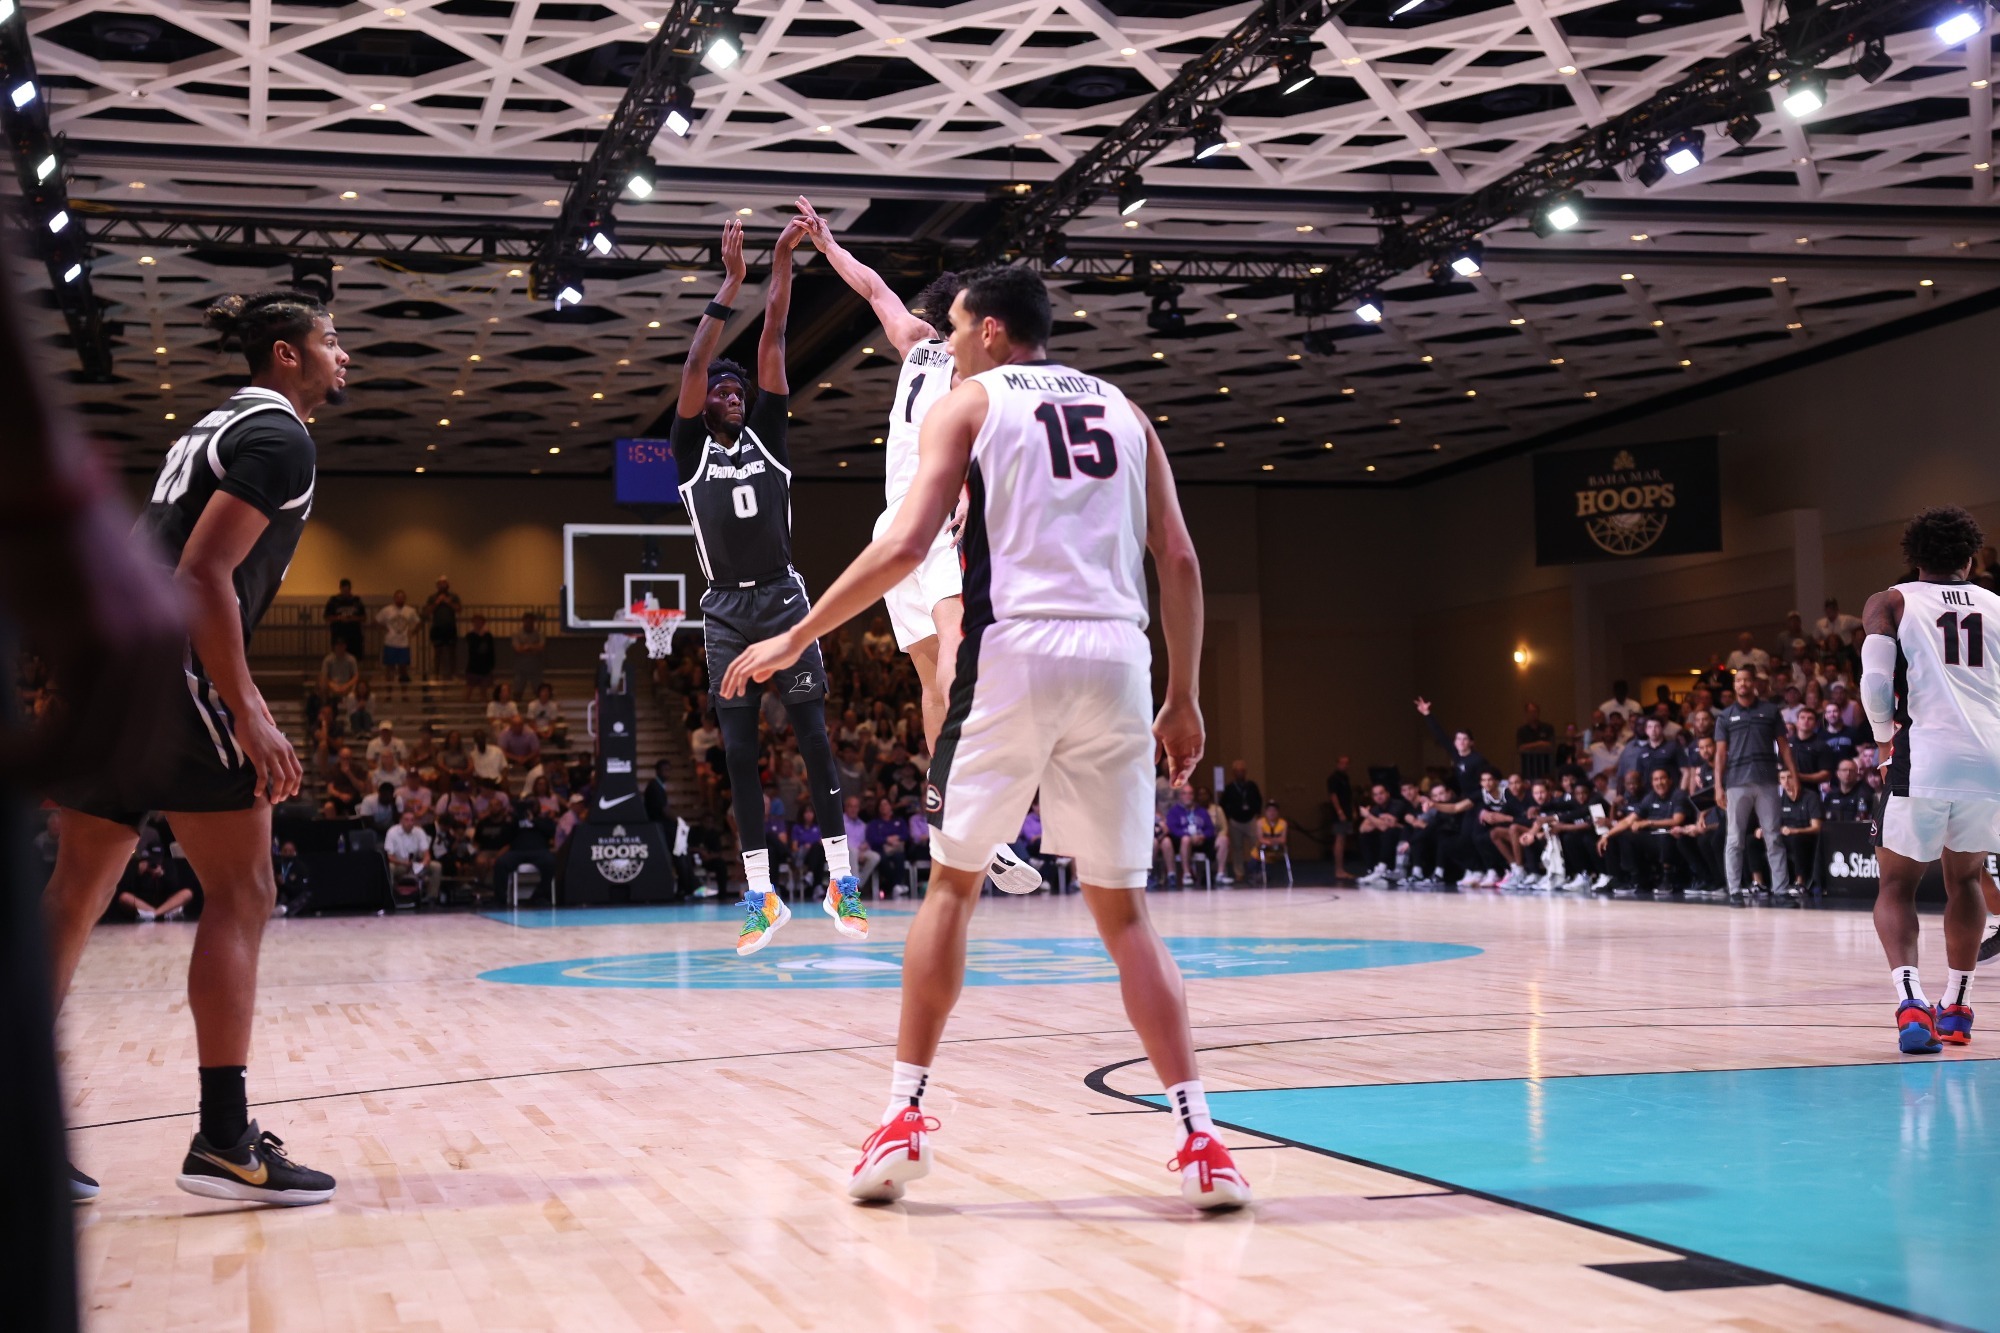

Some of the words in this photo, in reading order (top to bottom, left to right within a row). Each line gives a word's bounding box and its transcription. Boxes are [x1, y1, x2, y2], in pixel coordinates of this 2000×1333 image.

[905, 372, 927, 424] 1
[1003, 373, 1107, 398] MELENDEZ
[1034, 401, 1118, 480] 15
[705, 459, 766, 482] PROVIDENCE
[1588, 474, 1626, 487] BAHA
[1629, 469, 1664, 483] MAR
[731, 484, 759, 519] 0
[1576, 482, 1676, 518] HOOPS
[1941, 590, 1975, 607] HILL
[1936, 611, 1984, 668] 11
[591, 844, 649, 861] HOOPS
